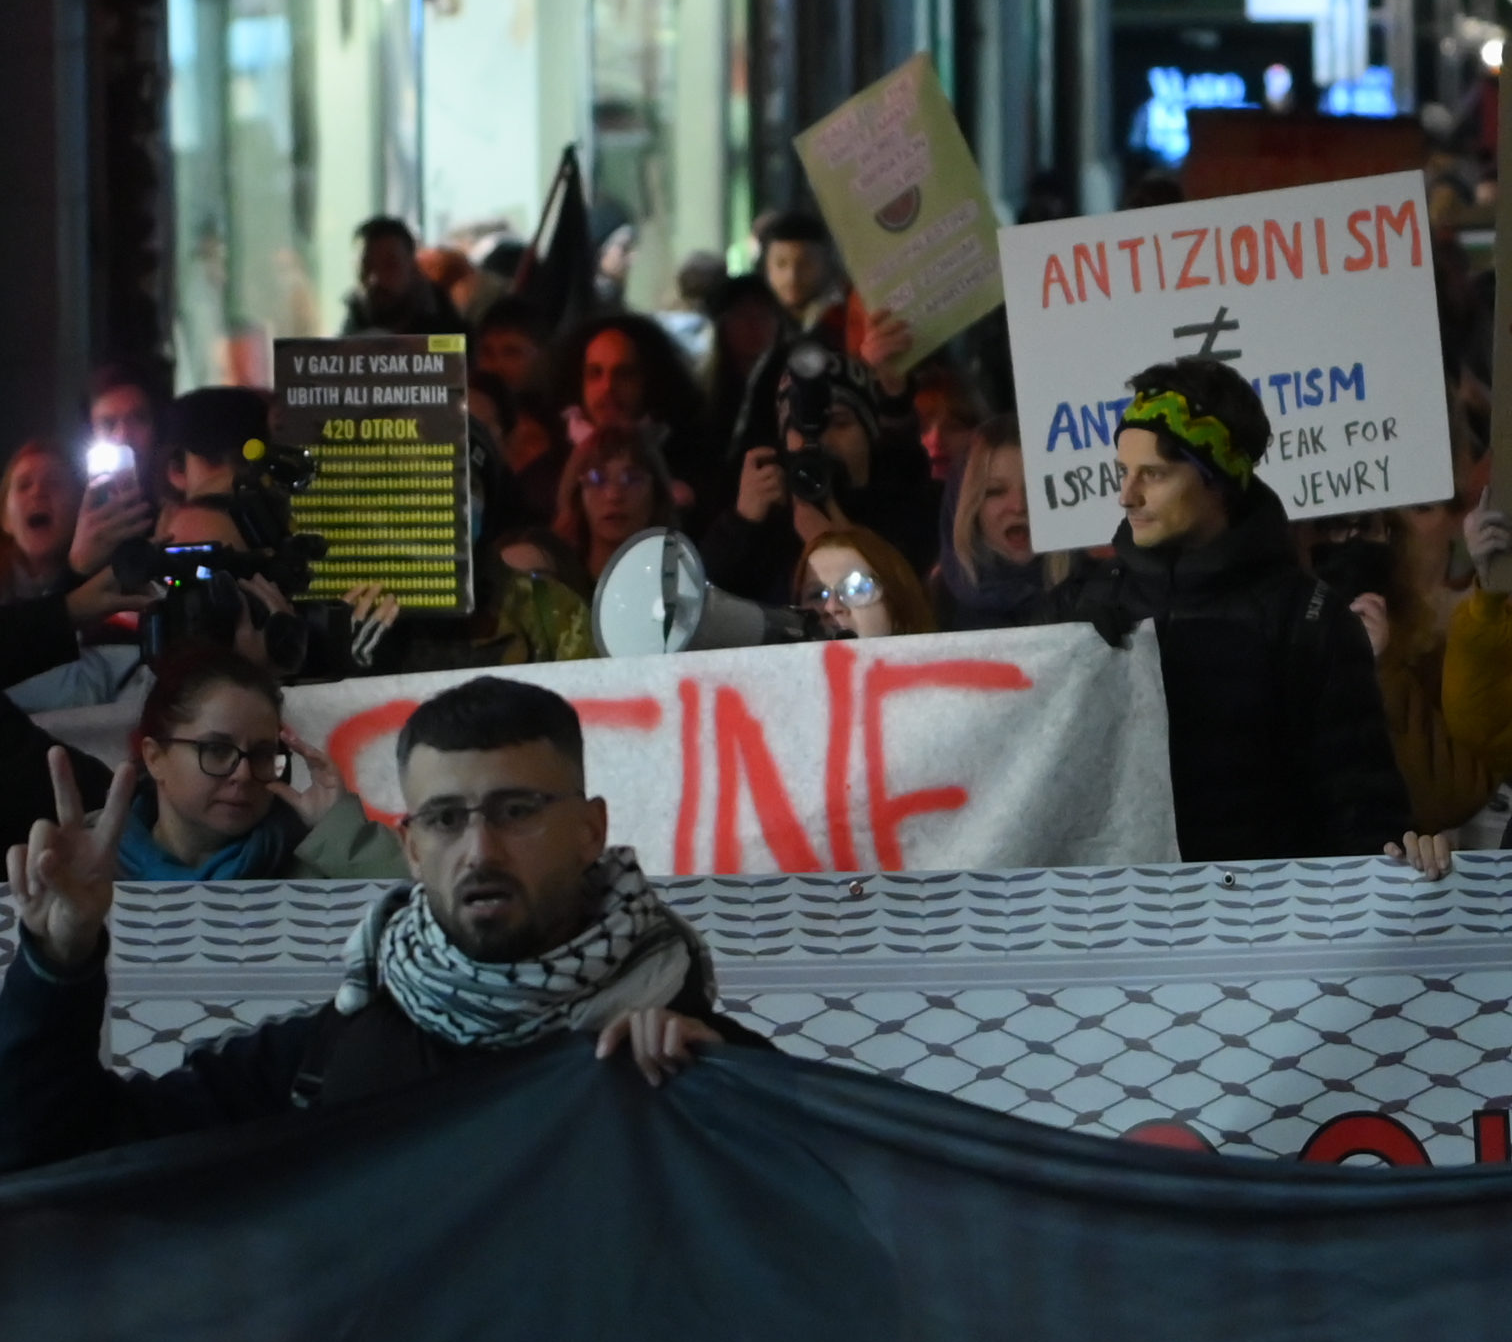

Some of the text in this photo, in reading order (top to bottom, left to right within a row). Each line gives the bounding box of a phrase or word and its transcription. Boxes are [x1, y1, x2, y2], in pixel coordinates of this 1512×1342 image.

[1041, 199, 1423, 309] ANTIZIONISM
[293, 354, 445, 375] V GAZI JE VSAK DAN
[286, 385, 449, 406] UBITIH ALI RANJENIH
[1045, 362, 1366, 453] ANTTISM
[322, 417, 420, 440] 420 OTROK
[1043, 416, 1399, 510] ISRA PEAK FOR
[1292, 456, 1391, 508] JEWRY
